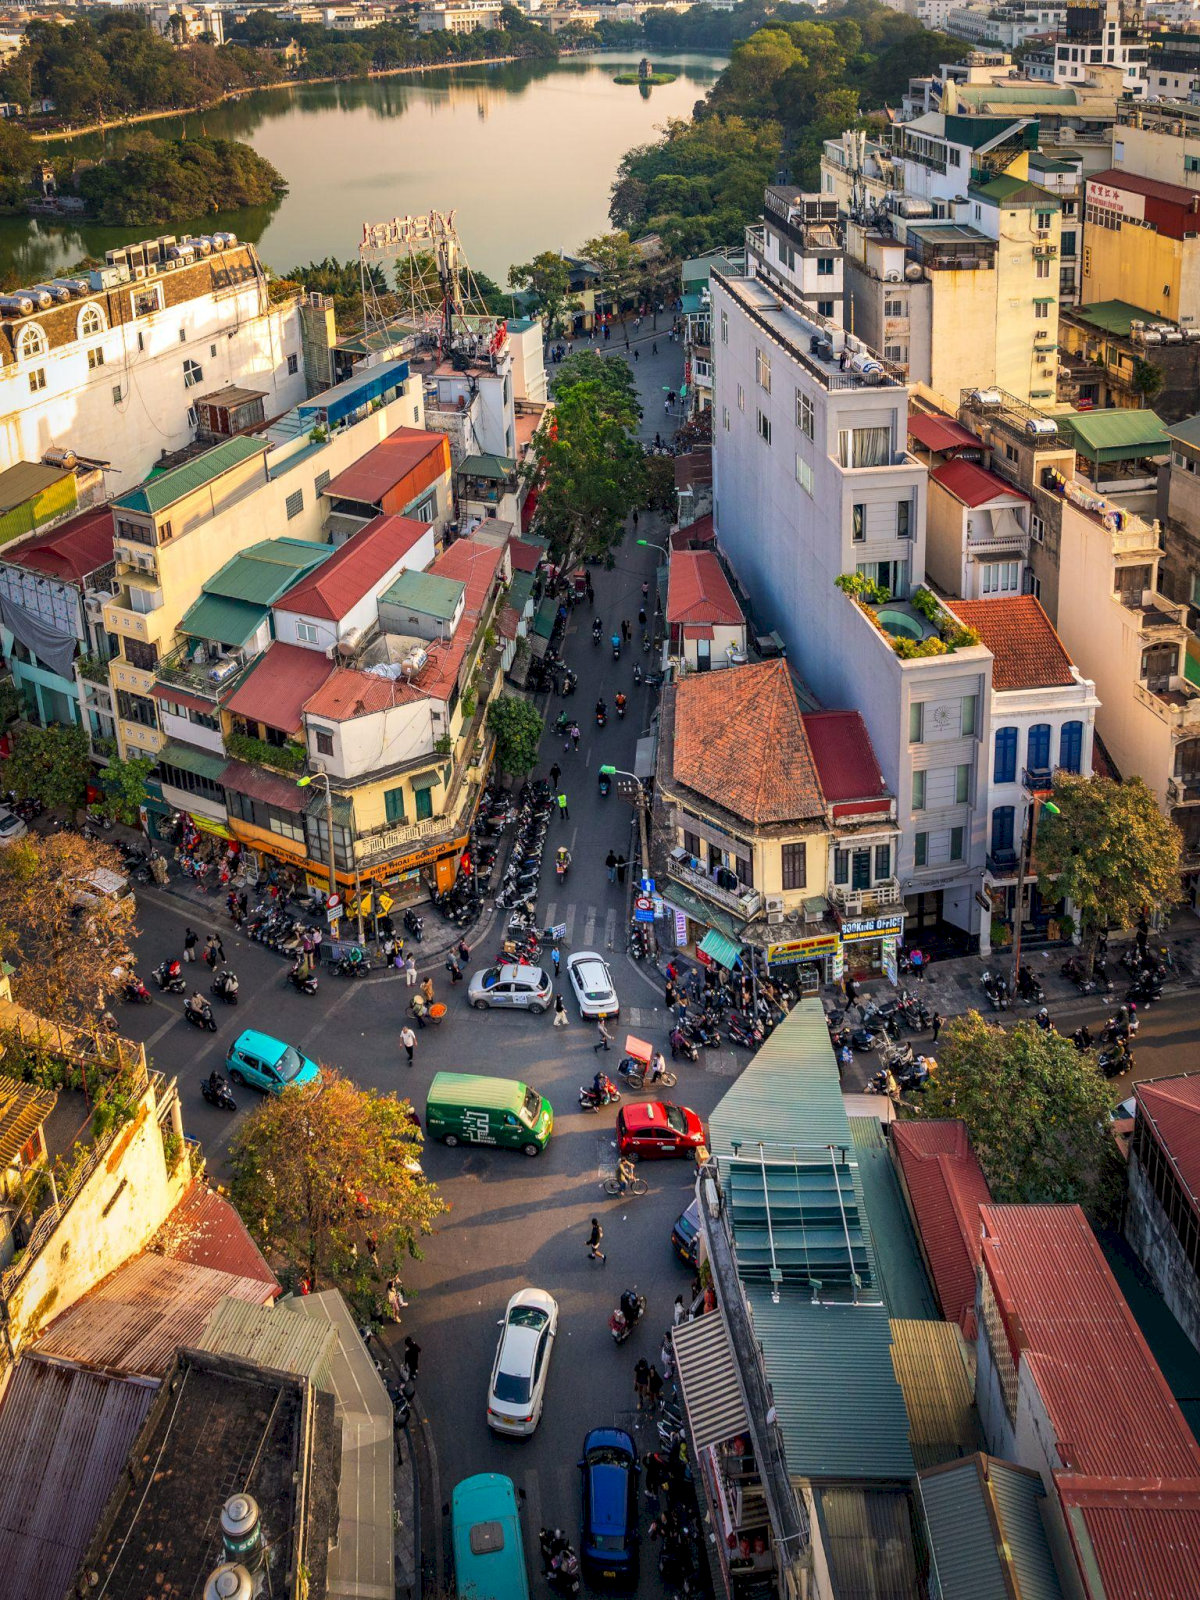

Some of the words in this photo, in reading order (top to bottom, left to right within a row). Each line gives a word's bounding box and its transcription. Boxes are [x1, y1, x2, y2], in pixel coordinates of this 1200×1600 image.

[370, 866, 387, 876] ĐIỆN
[389, 858, 410, 870] THOẠI
[416, 850, 435, 860] ĐỒNG
[436, 845, 446, 853] HỒ
[842, 921, 874, 933] BOOKING
[876, 918, 902, 929] OFFICE
[860, 929, 885, 938] INFORMATION
[772, 950, 806, 959] BOOKING
